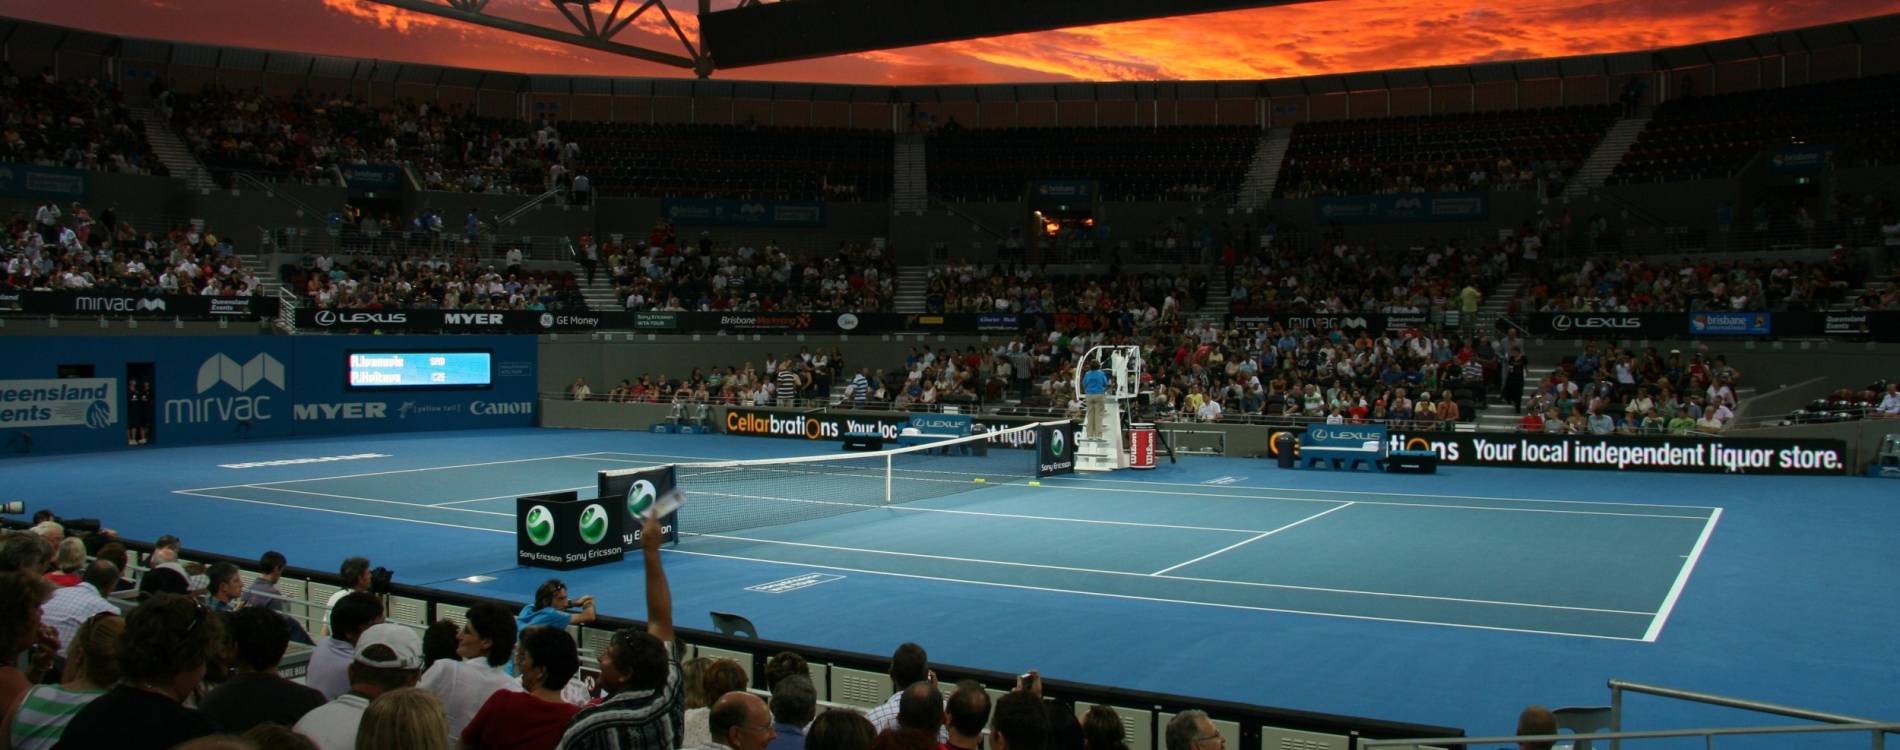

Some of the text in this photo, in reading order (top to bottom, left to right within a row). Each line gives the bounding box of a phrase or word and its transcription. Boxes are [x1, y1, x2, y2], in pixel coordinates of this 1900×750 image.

[75, 296, 134, 311] mirvac
[339, 313, 407, 324] LEXUS
[444, 313, 504, 325] MYER
[556, 315, 599, 327] GE Money
[721, 315, 756, 325] Brisbane
[1574, 317, 1641, 328] LEXUS
[1706, 315, 1746, 325] brisbane
[0, 384, 108, 401] eensland
[0, 408, 51, 422] ents
[165, 395, 271, 424] mirvac
[293, 402, 386, 420] MYER
[470, 401, 531, 415] Canon
[877, 420, 897, 439] loc
[999, 424, 1037, 447] liquo
[1329, 432, 1381, 440] LEXUS
[1145, 432, 1153, 465] Wilson
[1473, 439, 1517, 460] Your
[1521, 439, 1568, 462] local
[1575, 440, 1704, 467] independent
[1711, 443, 1773, 471] liquor
[1780, 446, 1843, 467] store.
[1041, 461, 1071, 472] Sony Ericsson
[520, 550, 562, 562] Sony Ericsson
[565, 547, 621, 563] Sony Ericsson
